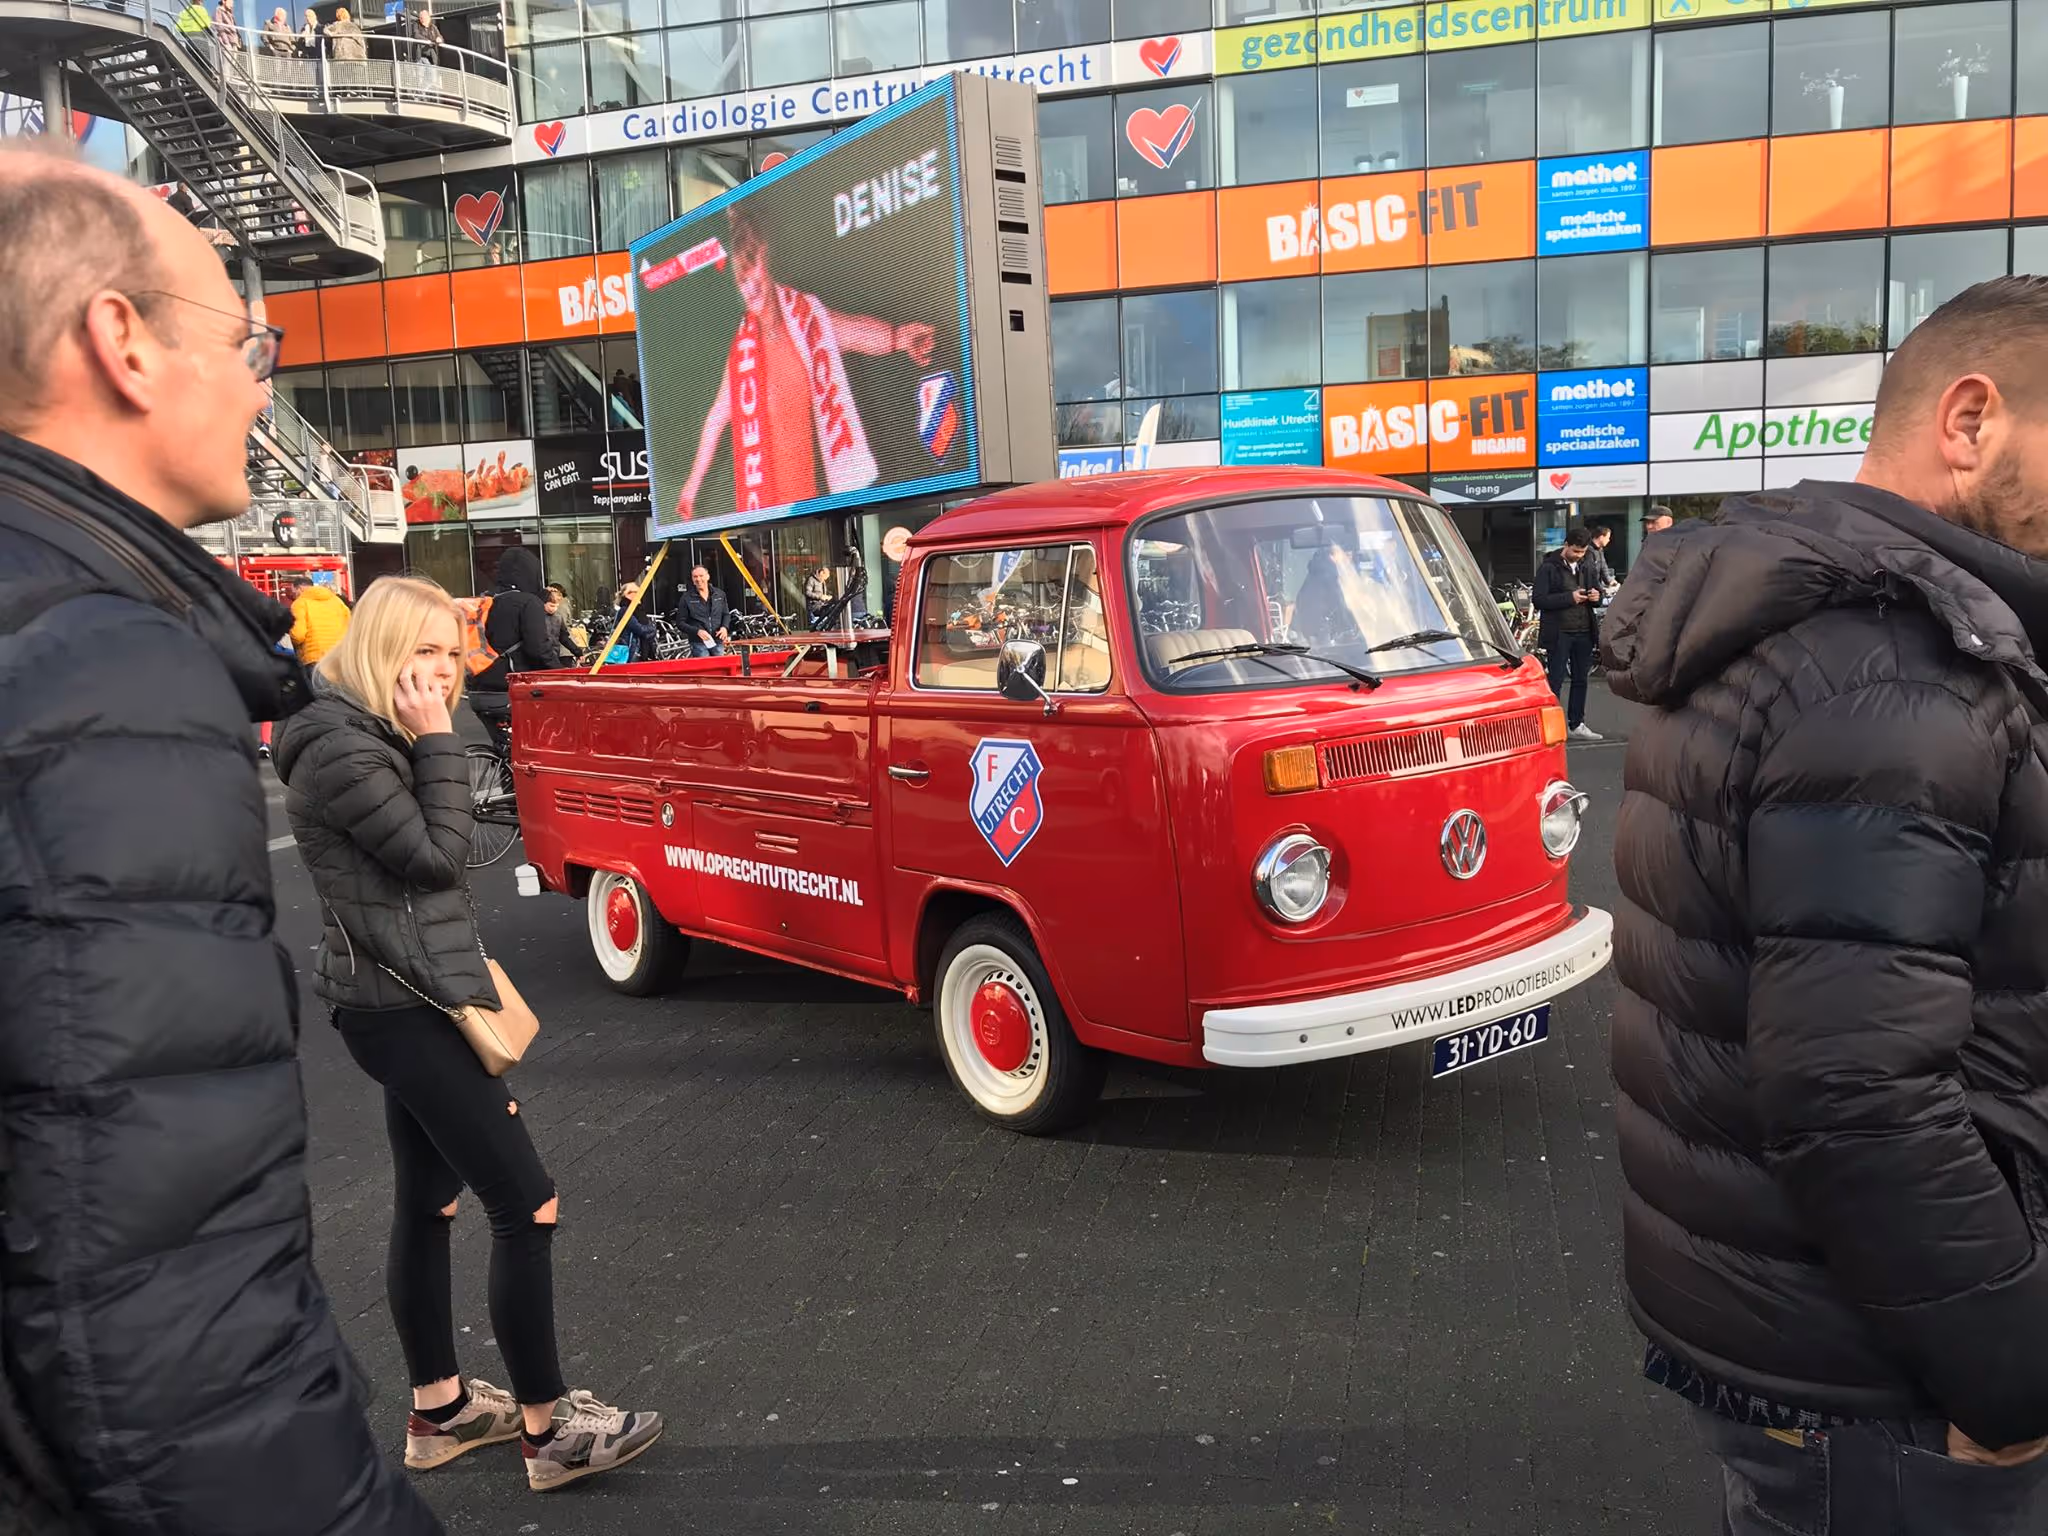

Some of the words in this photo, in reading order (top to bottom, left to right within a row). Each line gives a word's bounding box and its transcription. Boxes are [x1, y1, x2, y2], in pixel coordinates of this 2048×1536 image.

[1241, 0, 1627, 69] gezondheidscentrum
[622, 95, 796, 140] Cardiologie
[1551, 161, 1638, 188] mathot
[833, 147, 941, 238] DENISE
[1266, 180, 1483, 262] BASIC-FIT
[1560, 209, 1627, 226] medische
[1545, 222, 1642, 243] speciaalzaken
[1551, 378, 1636, 401] mathot
[1223, 415, 1278, 429] Huidkliniek
[1281, 414, 1319, 425] Utrecht
[1330, 389, 1529, 458] BASIC-FIT
[1560, 423, 1625, 438] medische
[1471, 436, 1527, 455] INGANG
[1545, 437, 1640, 454] speciaalzaken
[543, 467, 558, 481] ALL
[559, 460, 576, 474] YOU
[544, 479, 562, 492] CAN
[562, 471, 581, 486] EAT!
[592, 493, 642, 506] Teppanyaki
[1465, 484, 1500, 496] ingang
[987, 753, 998, 782] F
[980, 752, 1034, 835] UTRECHT
[1009, 806, 1026, 835] C
[664, 844, 864, 906] WWW.OPRECHTUTRECHT.NL
[1391, 957, 1576, 1030] WWW.LEDPROMOTIEBUS.NL
[1446, 1012, 1538, 1068] 31-YD-60
